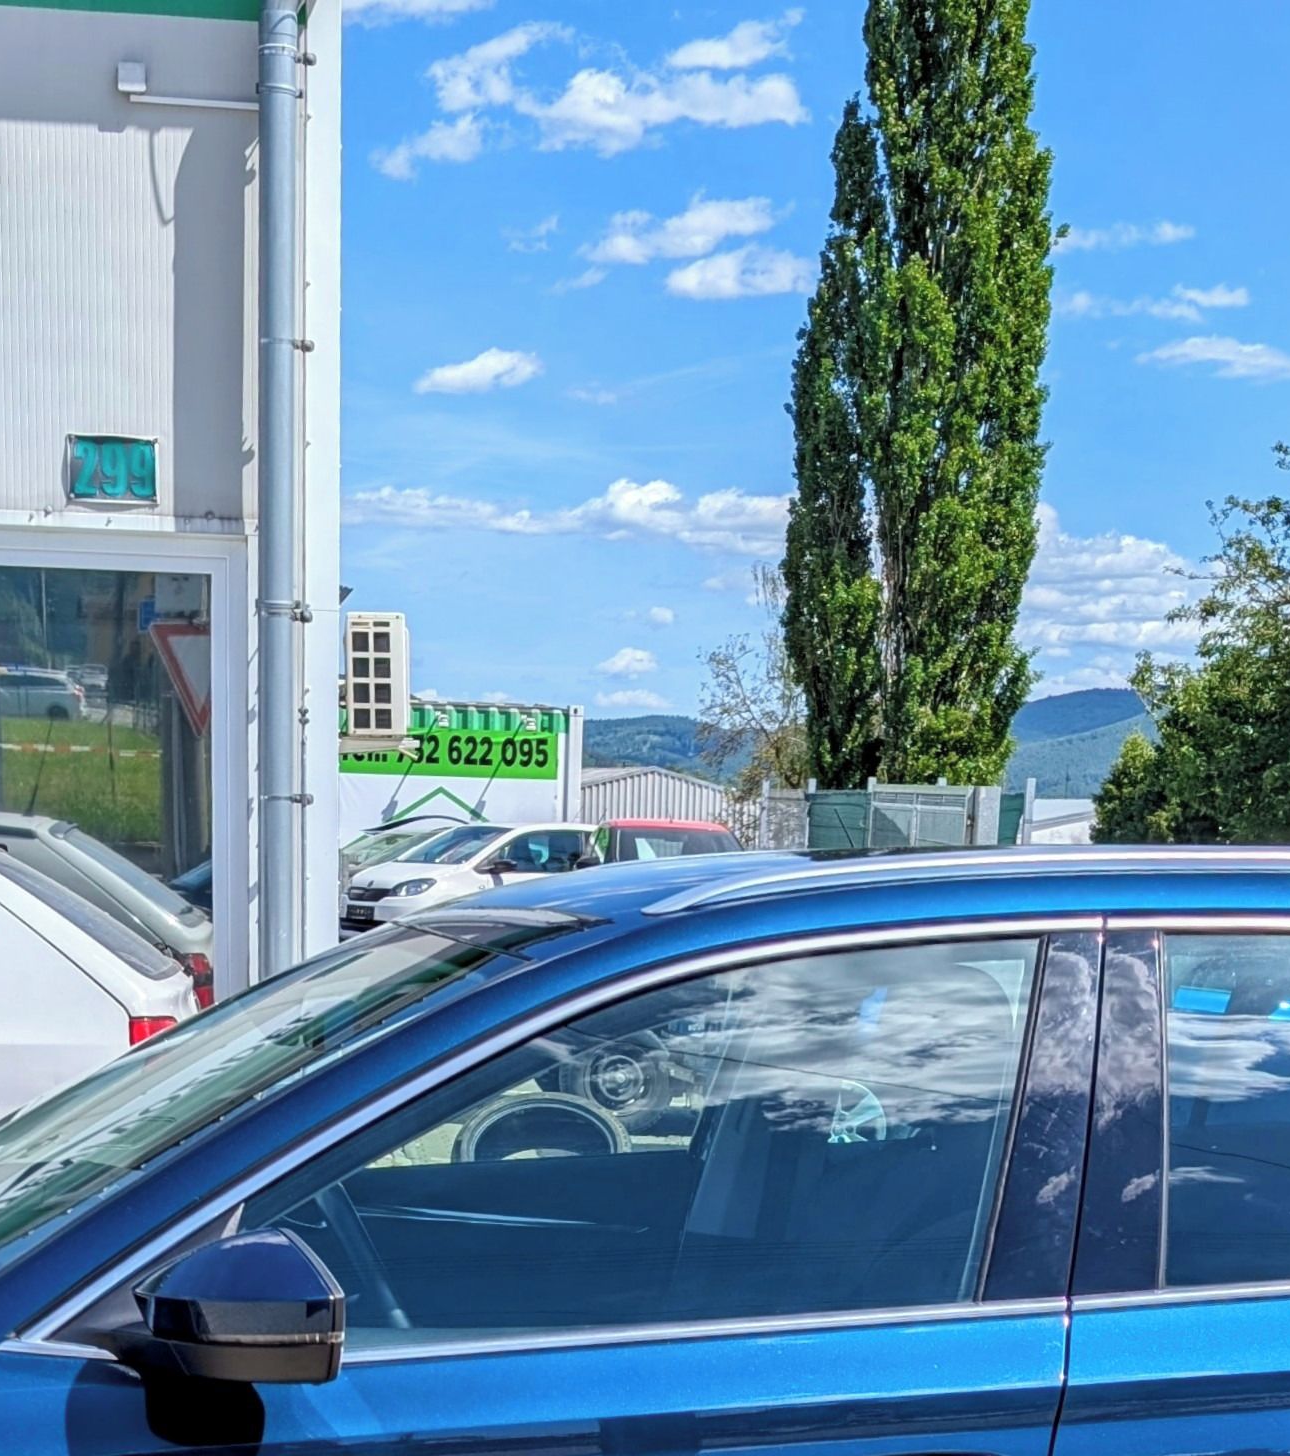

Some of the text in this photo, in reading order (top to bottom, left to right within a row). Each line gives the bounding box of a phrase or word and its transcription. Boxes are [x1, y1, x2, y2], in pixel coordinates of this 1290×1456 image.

[73, 439, 155, 498] 299
[448, 735, 493, 766] 622
[501, 738, 549, 768] 095
